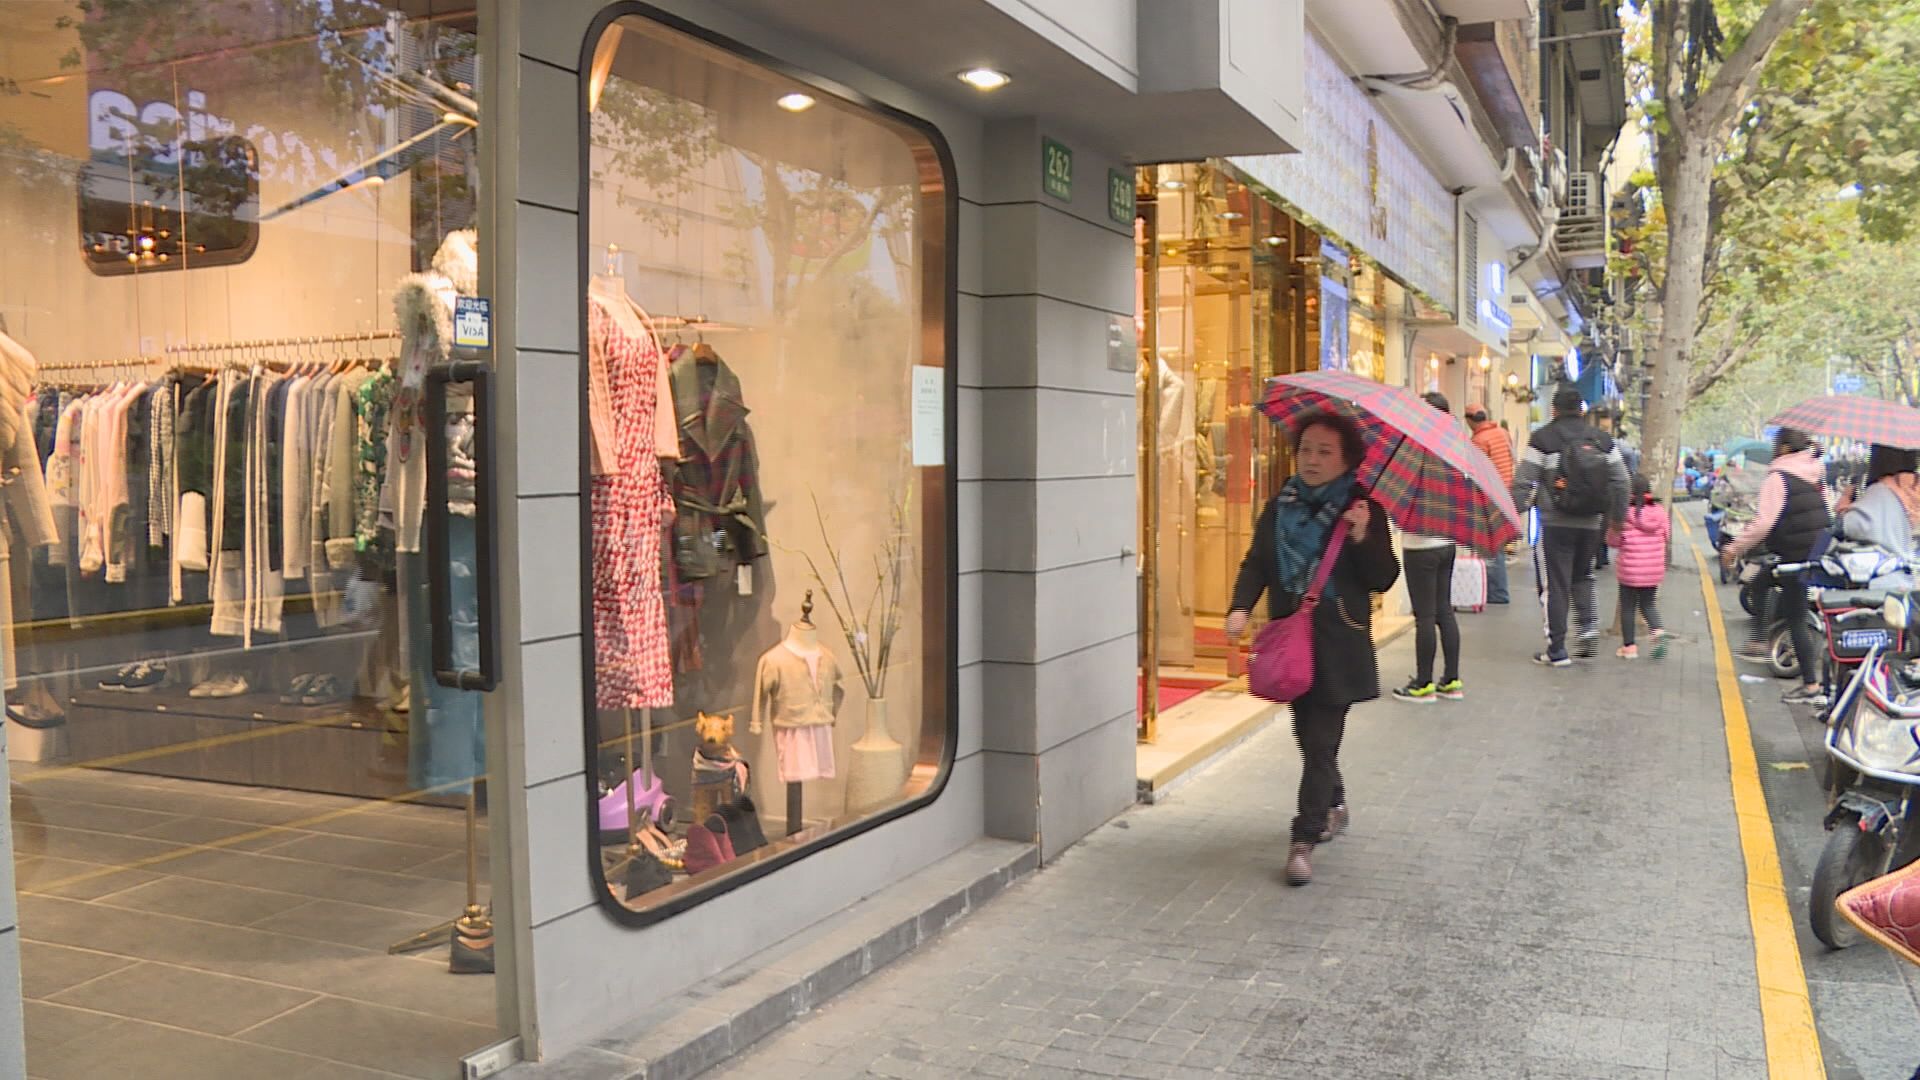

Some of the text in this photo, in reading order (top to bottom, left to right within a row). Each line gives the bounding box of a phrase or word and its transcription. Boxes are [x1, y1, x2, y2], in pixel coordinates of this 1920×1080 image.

[1048, 145, 1070, 182] 262
[1113, 177, 1132, 208] 260
[463, 326, 485, 337] VISA
